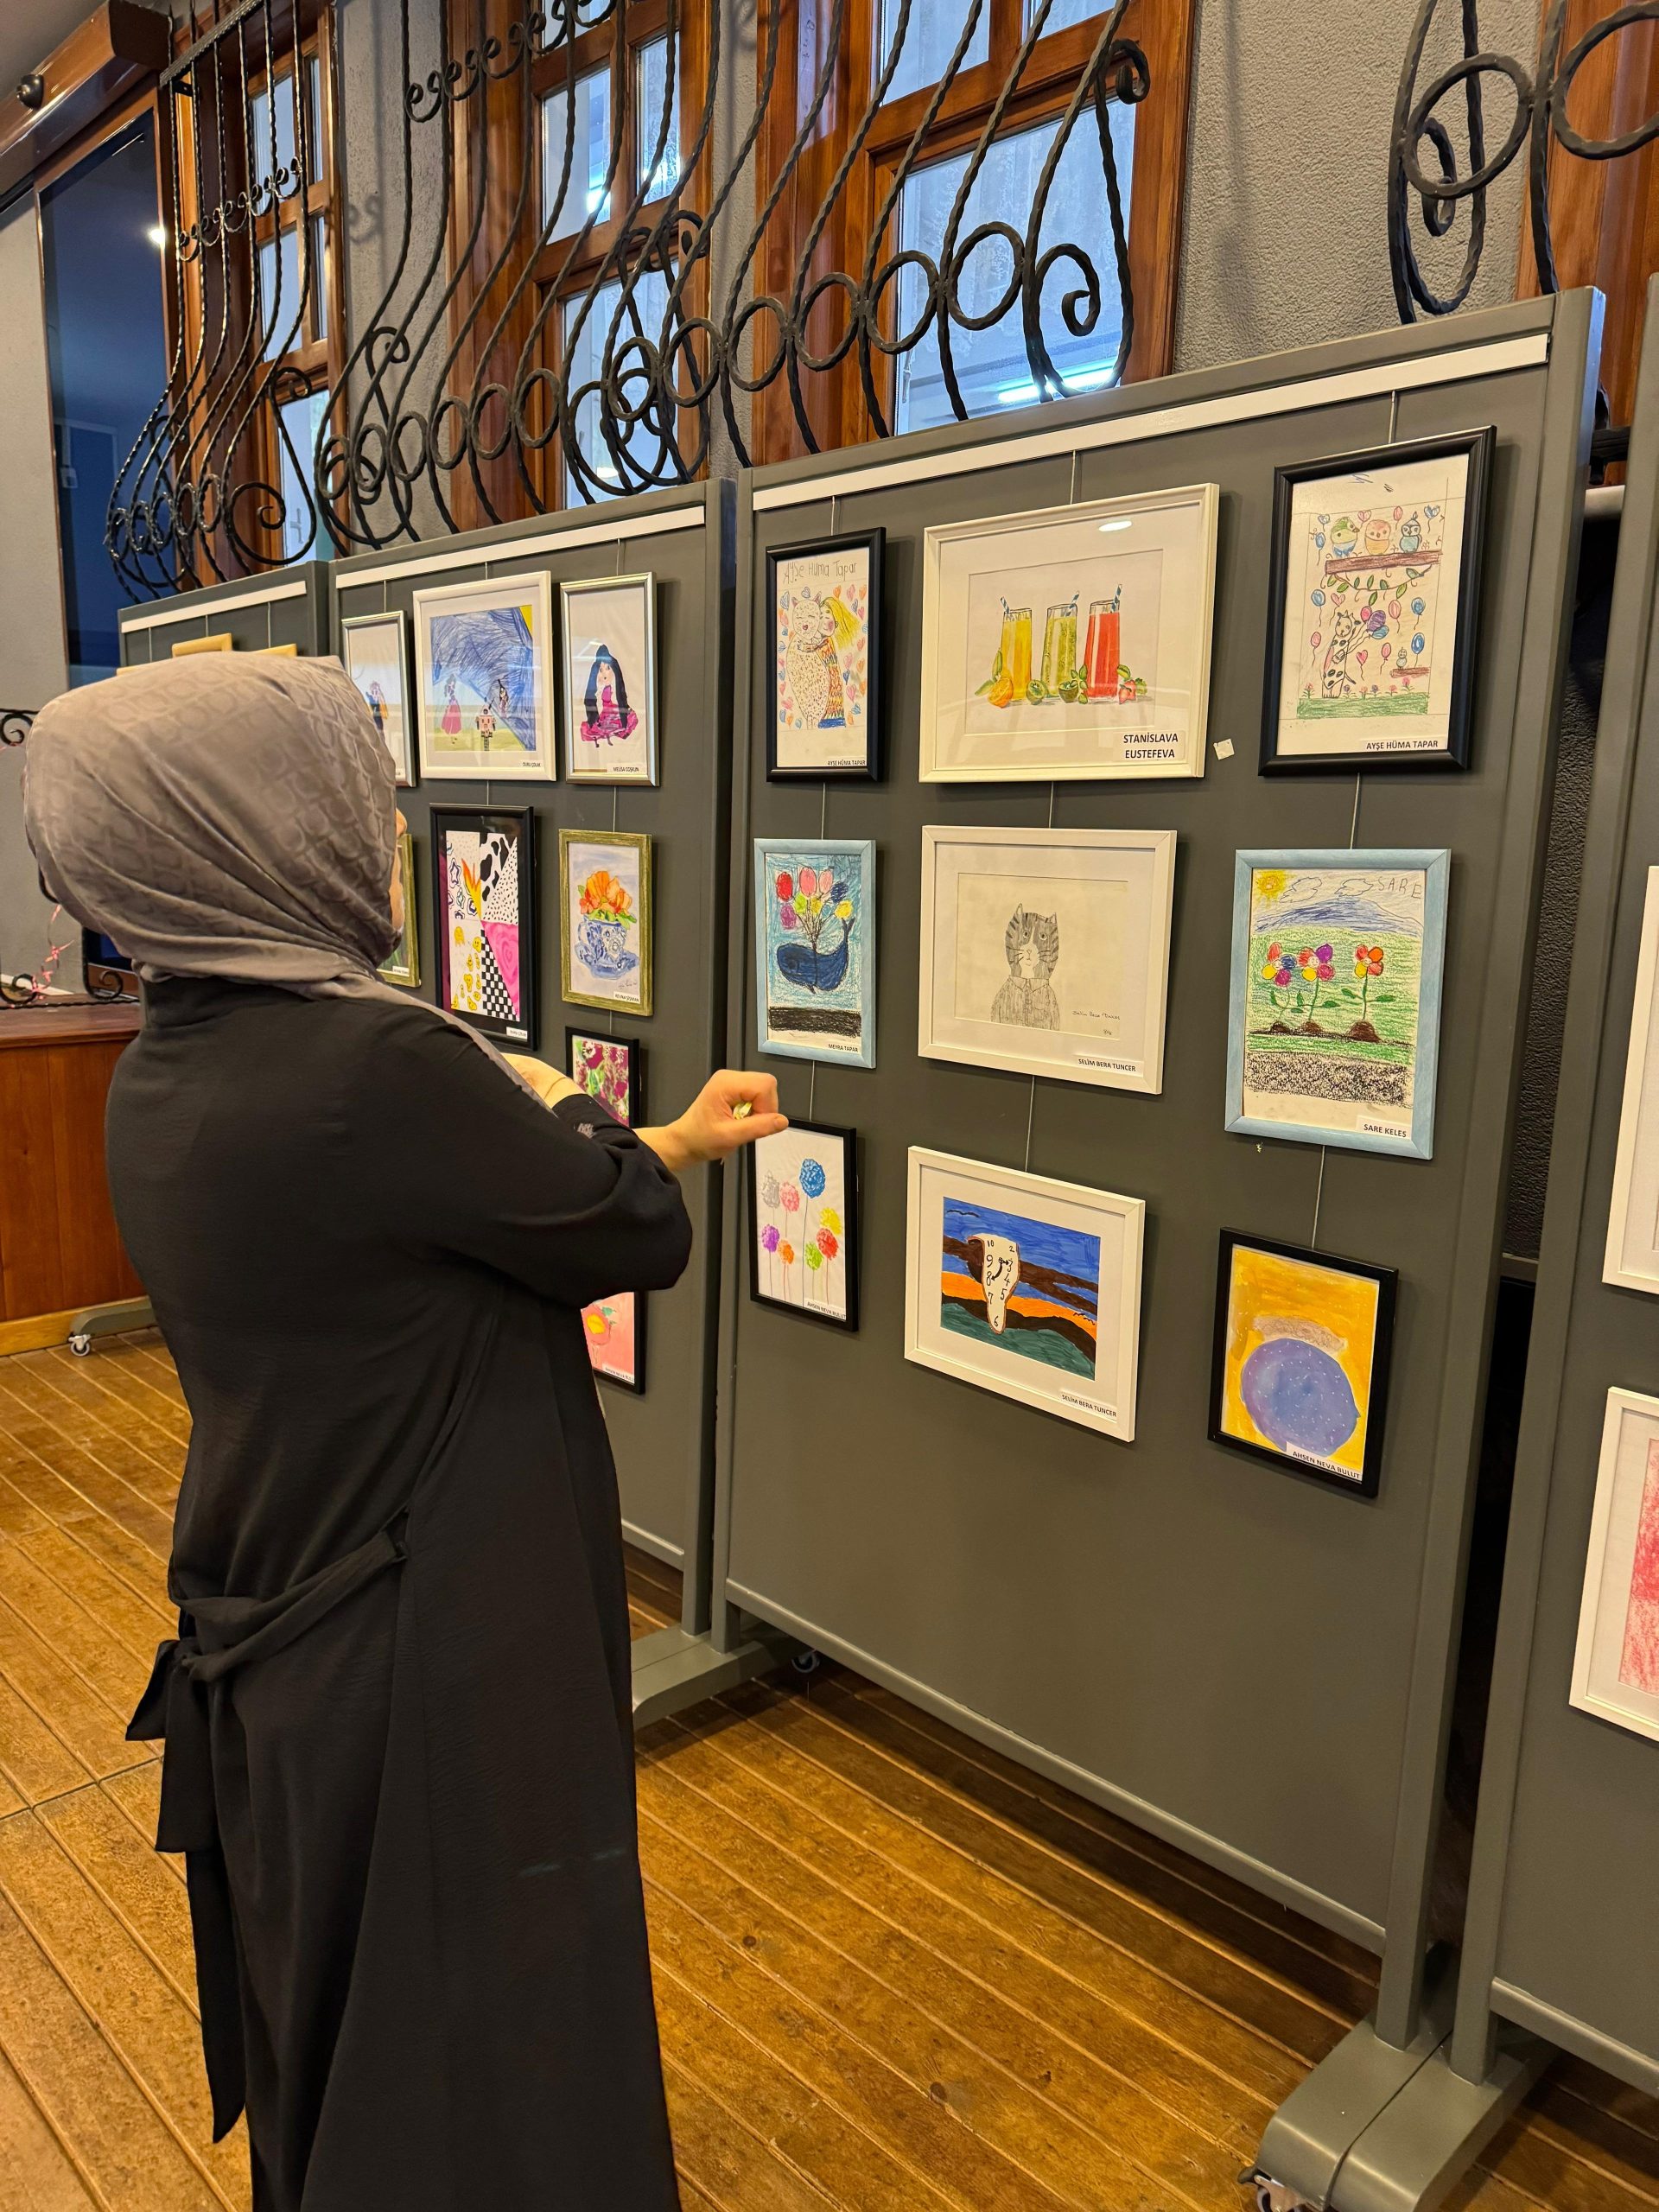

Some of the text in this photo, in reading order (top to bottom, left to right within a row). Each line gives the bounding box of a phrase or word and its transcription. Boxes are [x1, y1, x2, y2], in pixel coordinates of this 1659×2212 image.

[832, 560, 857, 581] Tapar
[1123, 732, 1179, 743] STANİSLAVA
[1366, 742, 1384, 751] AYŞE
[1386, 741, 1411, 749] HÜMA
[1125, 749, 1175, 759] EUSTEFEVA
[1378, 876, 1422, 899] SARE
[1113, 1063, 1136, 1071] TUNCER
[1363, 1123, 1383, 1133] SARE
[986, 1254, 994, 1268] 9
[1007, 1258, 1014, 1273] 3
[986, 1271, 992, 1287] 8
[1004, 1273, 1010, 1287] 4
[988, 1292, 994, 1305] 7
[1000, 1288, 1007, 1300] 5
[994, 1315, 999, 1327] 6
[1078, 1400, 1094, 1409] BERA
[1093, 1405, 1117, 1417] TUNCER
[1293, 1451, 1360, 1479] AHSEN NEVA BULUT
